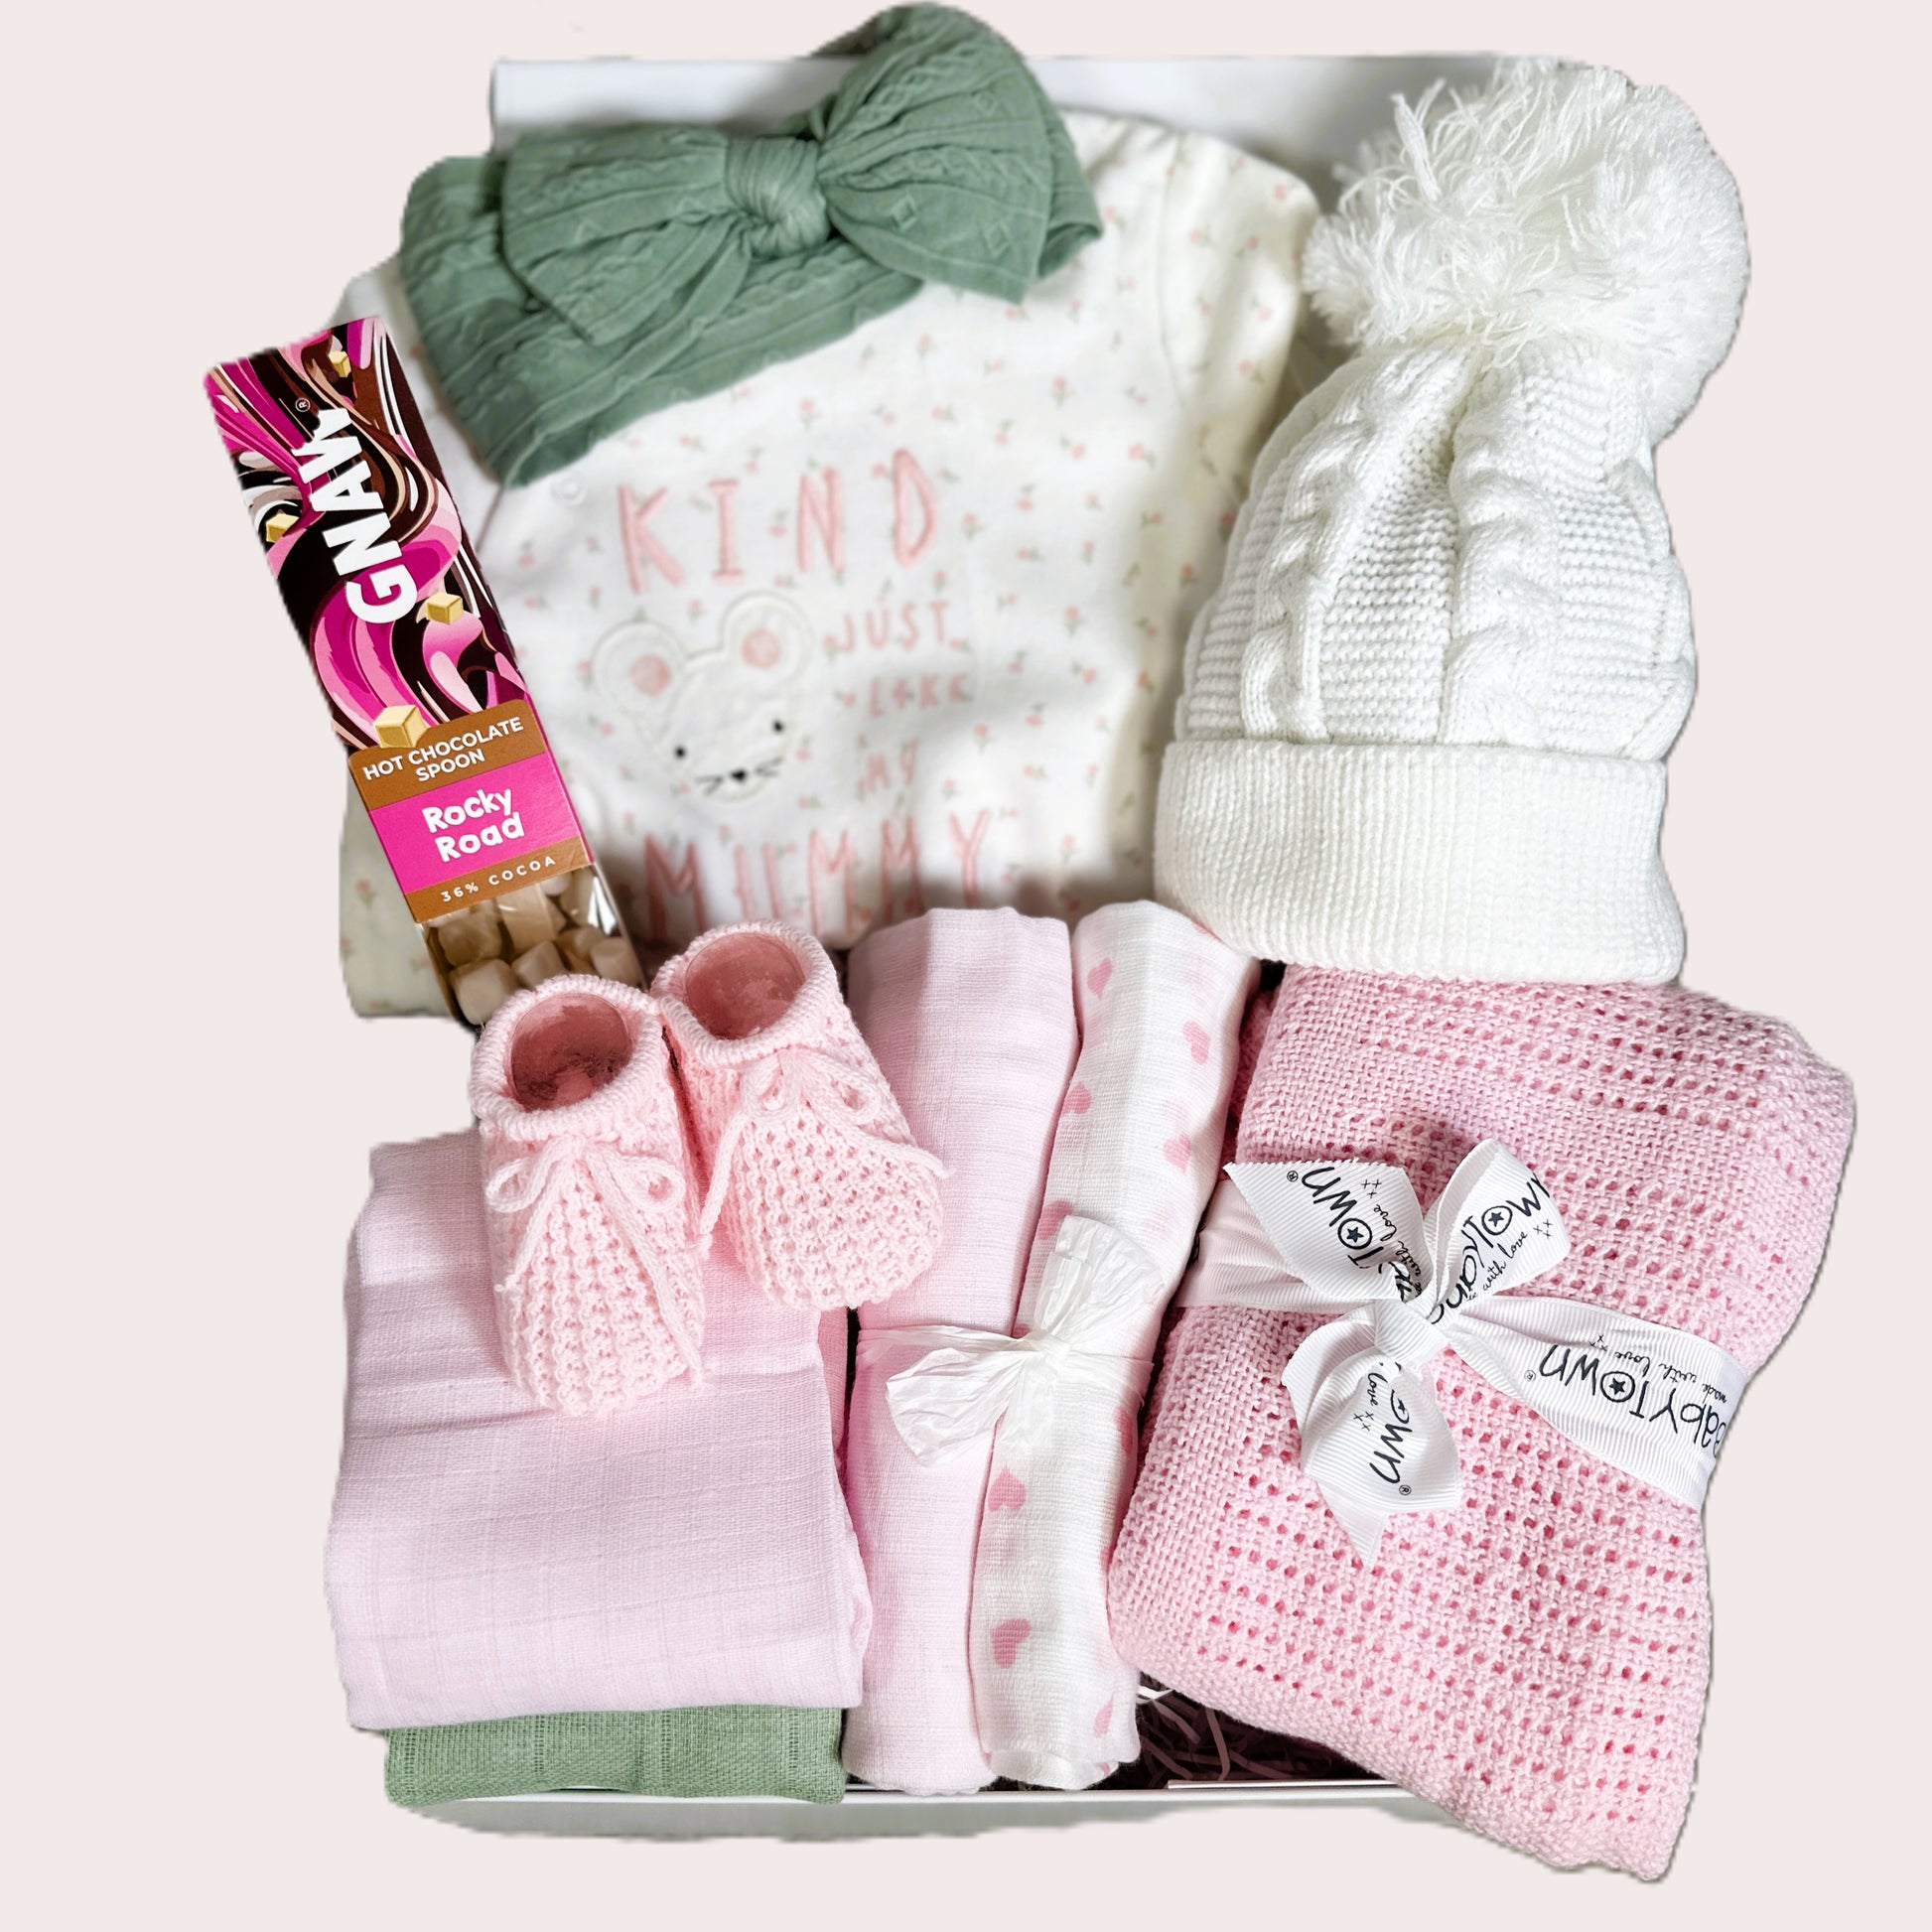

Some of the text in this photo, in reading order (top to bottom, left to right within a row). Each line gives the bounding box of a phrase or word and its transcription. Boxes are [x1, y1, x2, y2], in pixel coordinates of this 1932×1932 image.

[291, 407, 418, 623] GNAK
[618, 448, 937, 596] KIND
[837, 600, 950, 653] JUST
[362, 716, 524, 780] HOT CHOCOLATE
[415, 749, 485, 782] SPOON
[421, 788, 512, 834] Rocky
[434, 811, 525, 862] Road
[440, 856, 556, 902] 36% COCOA
[1373, 1203, 1398, 1242] love
[1496, 1231, 1529, 1260] love
[1613, 1350, 1651, 1378] love
[1367, 1372, 1389, 1407] love
